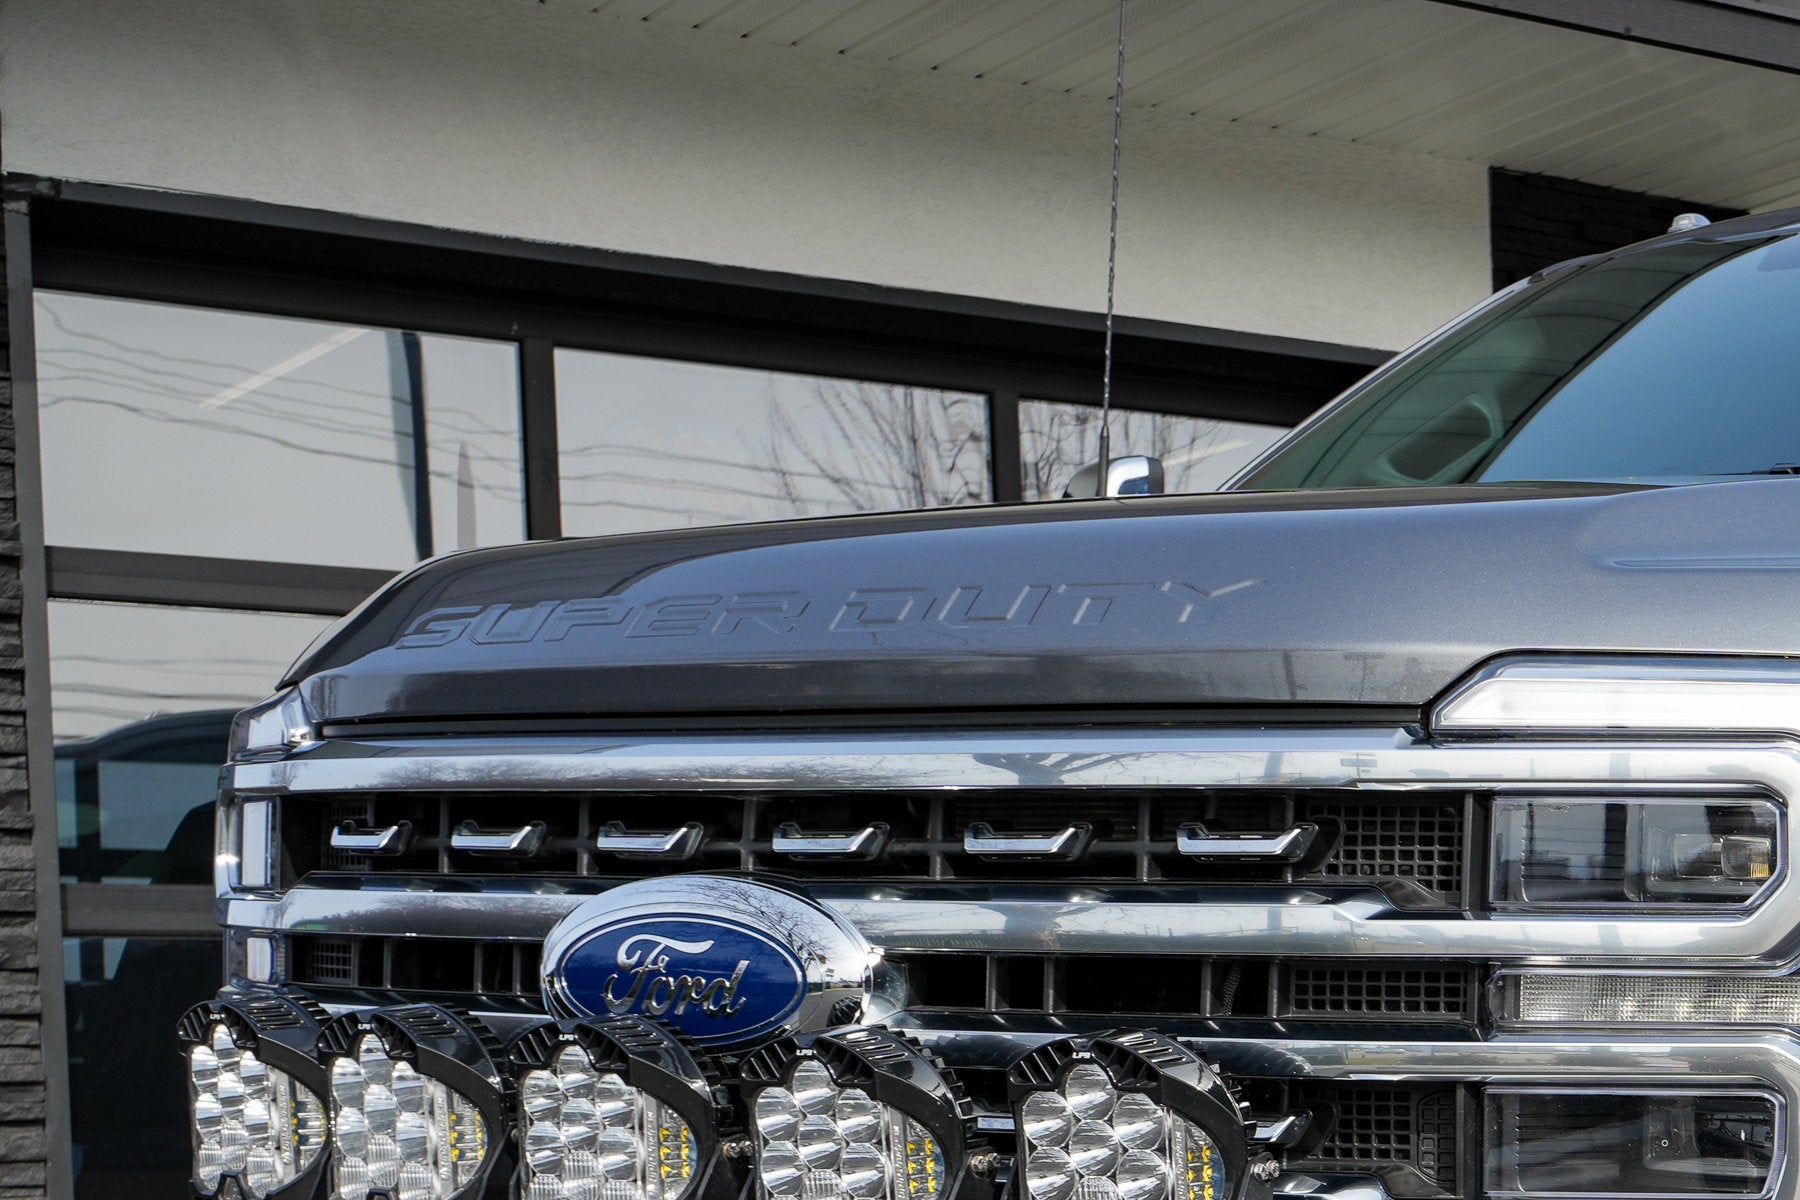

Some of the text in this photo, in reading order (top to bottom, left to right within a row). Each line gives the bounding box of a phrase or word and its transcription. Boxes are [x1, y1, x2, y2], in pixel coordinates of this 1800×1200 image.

[396, 577, 1268, 650] SUPER DUTY
[603, 933, 751, 1017] Ford
[1072, 1051, 1091, 1059] LP9
